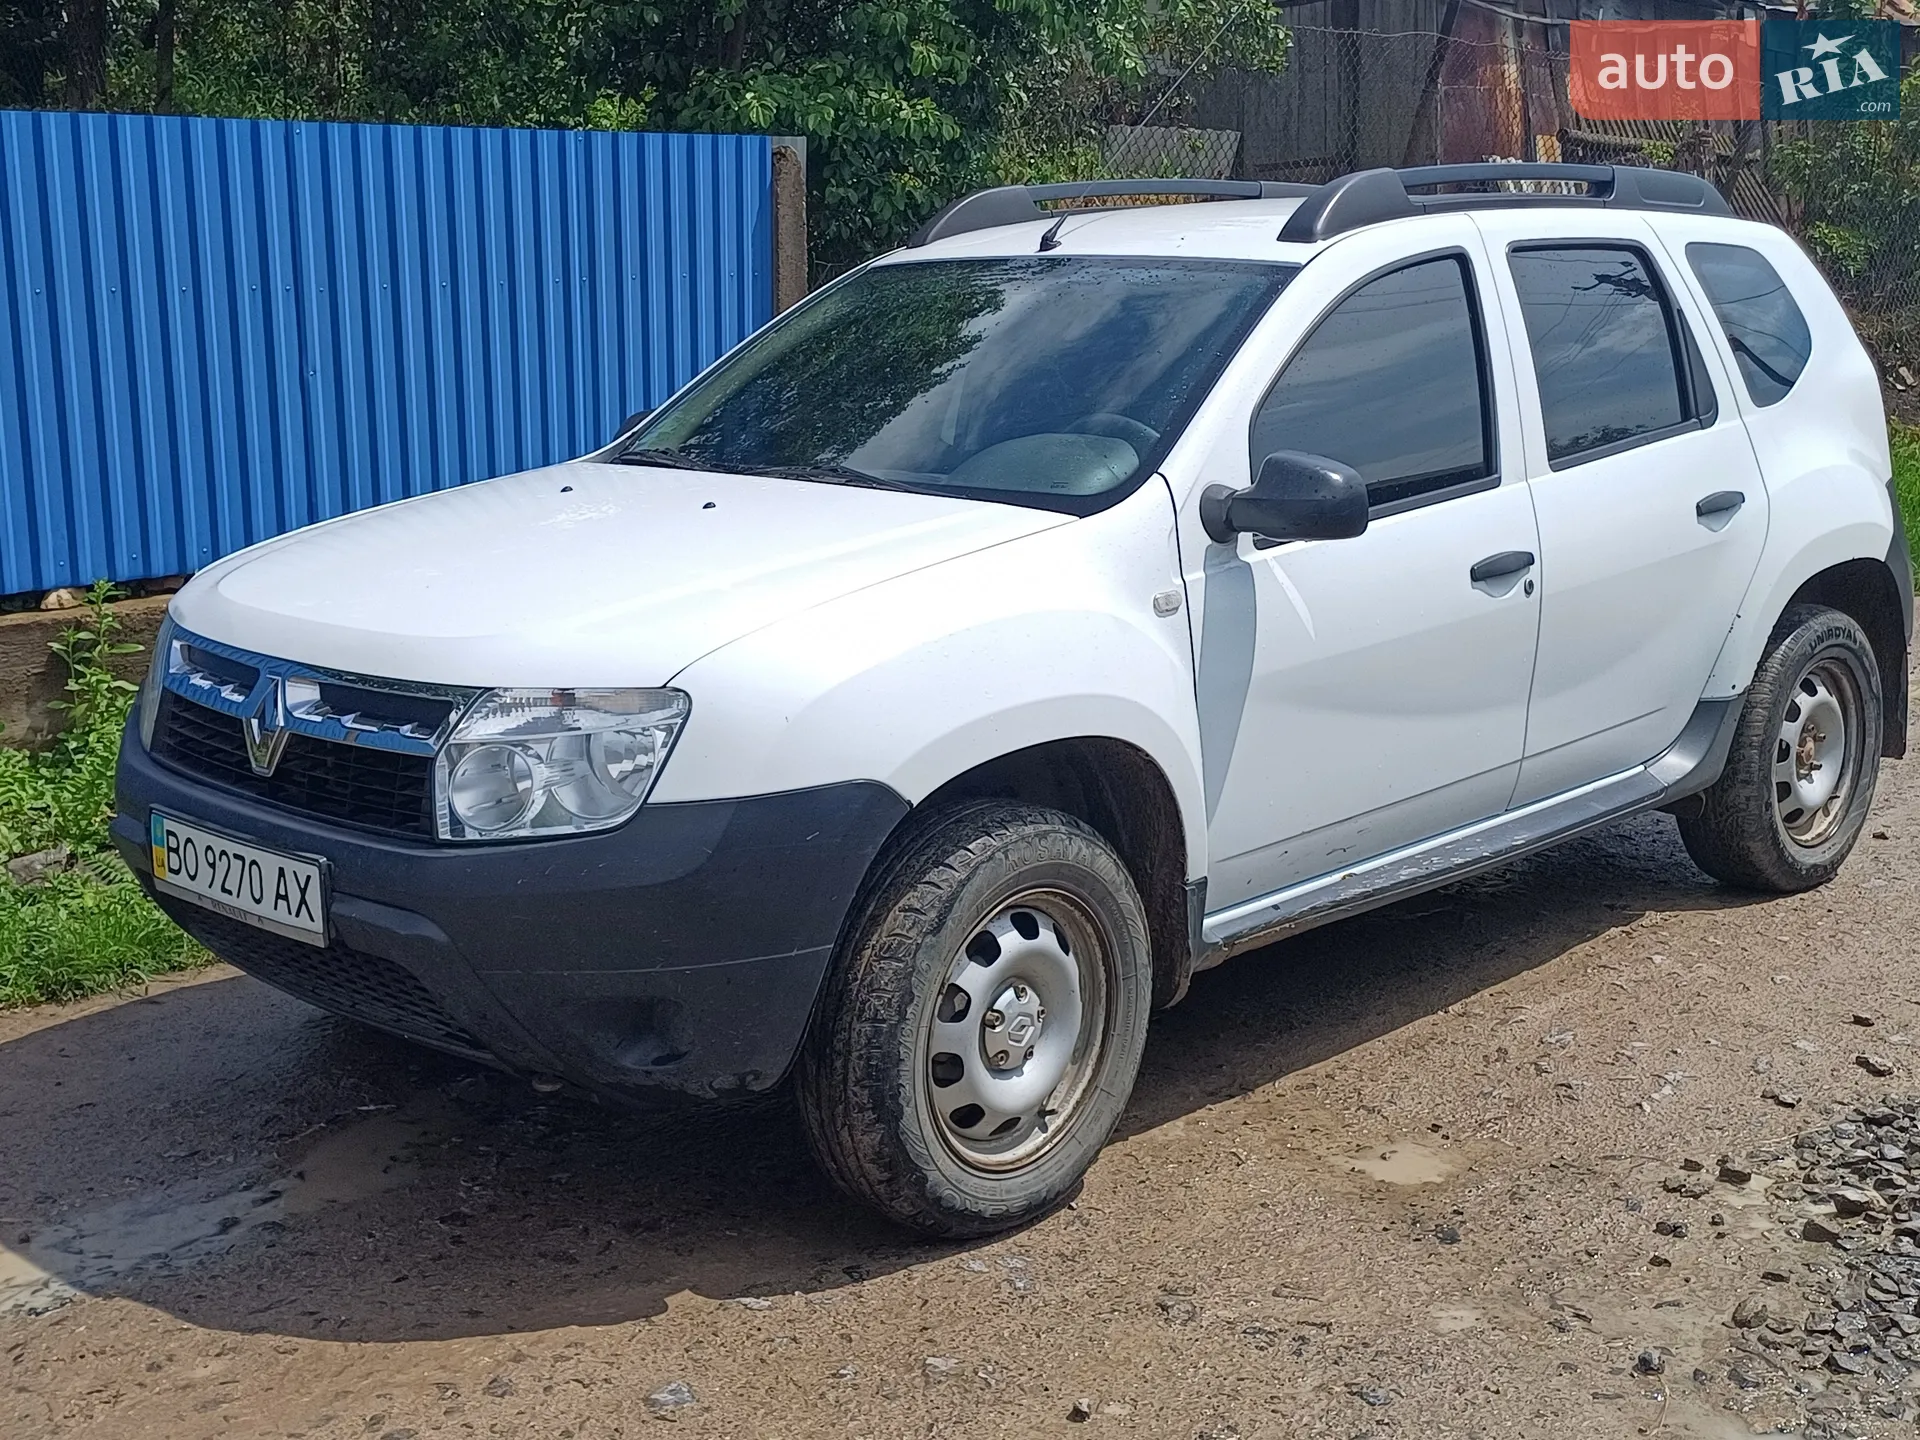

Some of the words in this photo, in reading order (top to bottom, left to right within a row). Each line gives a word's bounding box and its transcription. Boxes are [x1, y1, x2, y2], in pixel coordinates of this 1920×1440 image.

[166, 829, 199, 882] BO
[205, 845, 263, 905] 9270
[274, 867, 315, 923] AX
